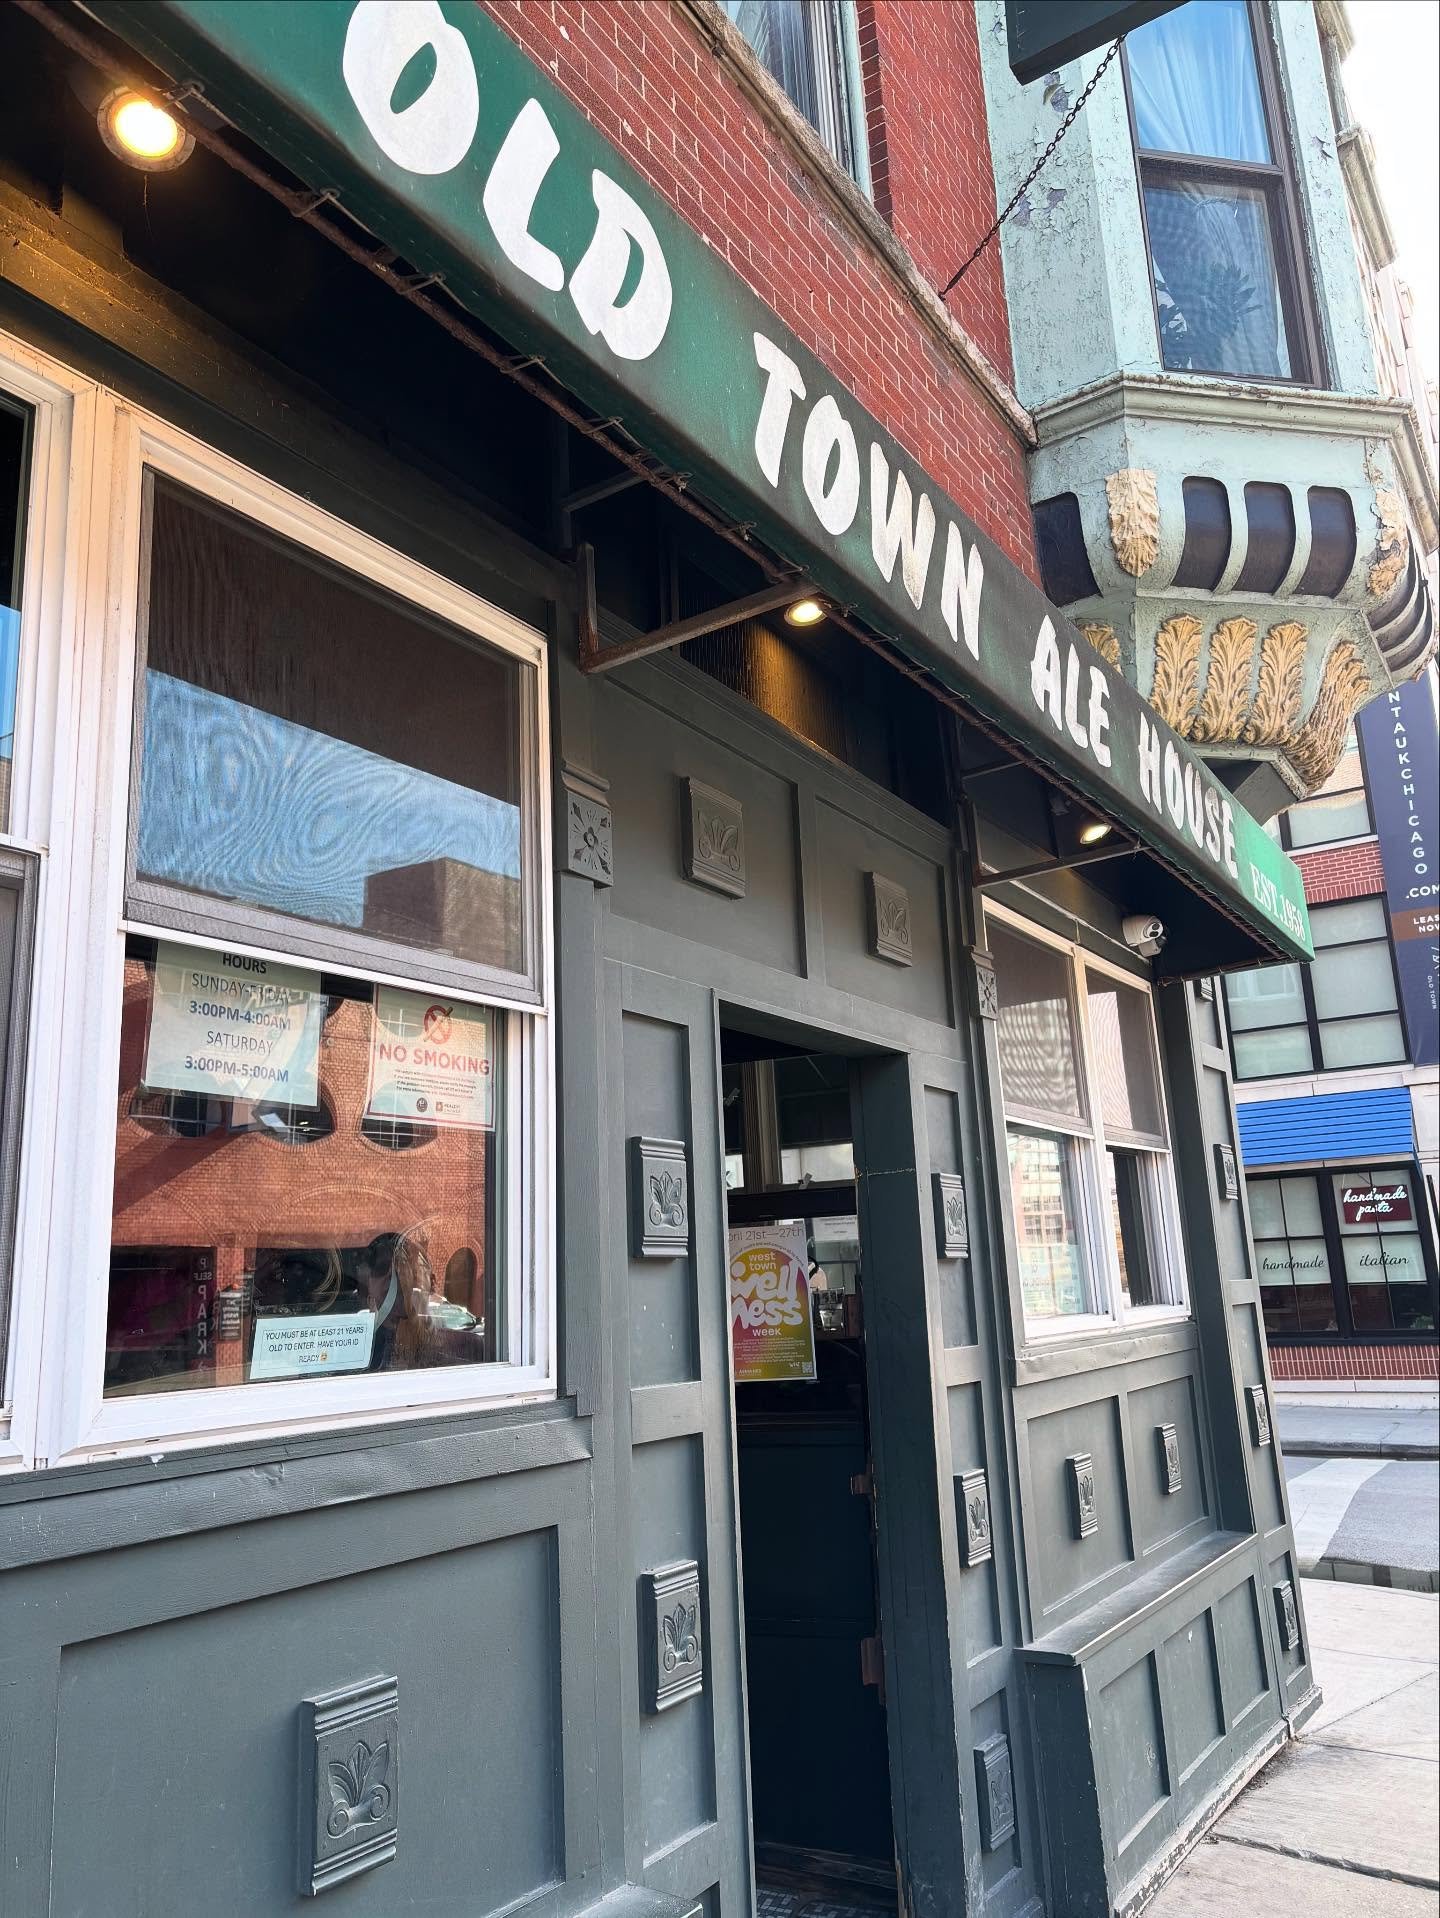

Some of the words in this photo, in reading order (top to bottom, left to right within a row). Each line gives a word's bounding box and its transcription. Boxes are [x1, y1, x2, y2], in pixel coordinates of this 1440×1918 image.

[343, 0, 673, 361] OLD
[753, 332, 985, 661] TOWN
[1030, 614, 1112, 768] ALE
[1137, 711, 1239, 880] HOUSE
[222, 953, 267, 974] HOURS
[189, 1000, 291, 1031] 3:00PM-4:00AM
[206, 1030, 274, 1055] SATURDAY
[379, 1043, 407, 1063] NO
[413, 1048, 490, 1077] SMOKING
[184, 1055, 289, 1083] 3:00PM-5:00AM
[1343, 1185, 1408, 1203] handmade
[1355, 1201, 1393, 1221] pasta
[748, 1251, 776, 1262] west
[1263, 1255, 1325, 1270] handmade
[1359, 1252, 1409, 1267] italian
[749, 1261, 777, 1271] town
[266, 1331, 280, 1340] YOU
[281, 1330, 300, 1339] MUST
[300, 1329, 309, 1338] BE
[309, 1329, 317, 1337] AT
[318, 1328, 337, 1337] LEAST
[337, 1328, 344, 1336] 21
[345, 1326, 364, 1335] YEARS
[752, 1328, 782, 1337] week
[268, 1344, 283, 1353] OLD
[284, 1343, 292, 1351] TO
[317, 1340, 334, 1348] HAVE
[334, 1339, 352, 1347] YOUR
[352, 1338, 359, 1346] ID
[298, 1354, 320, 1363] READY
